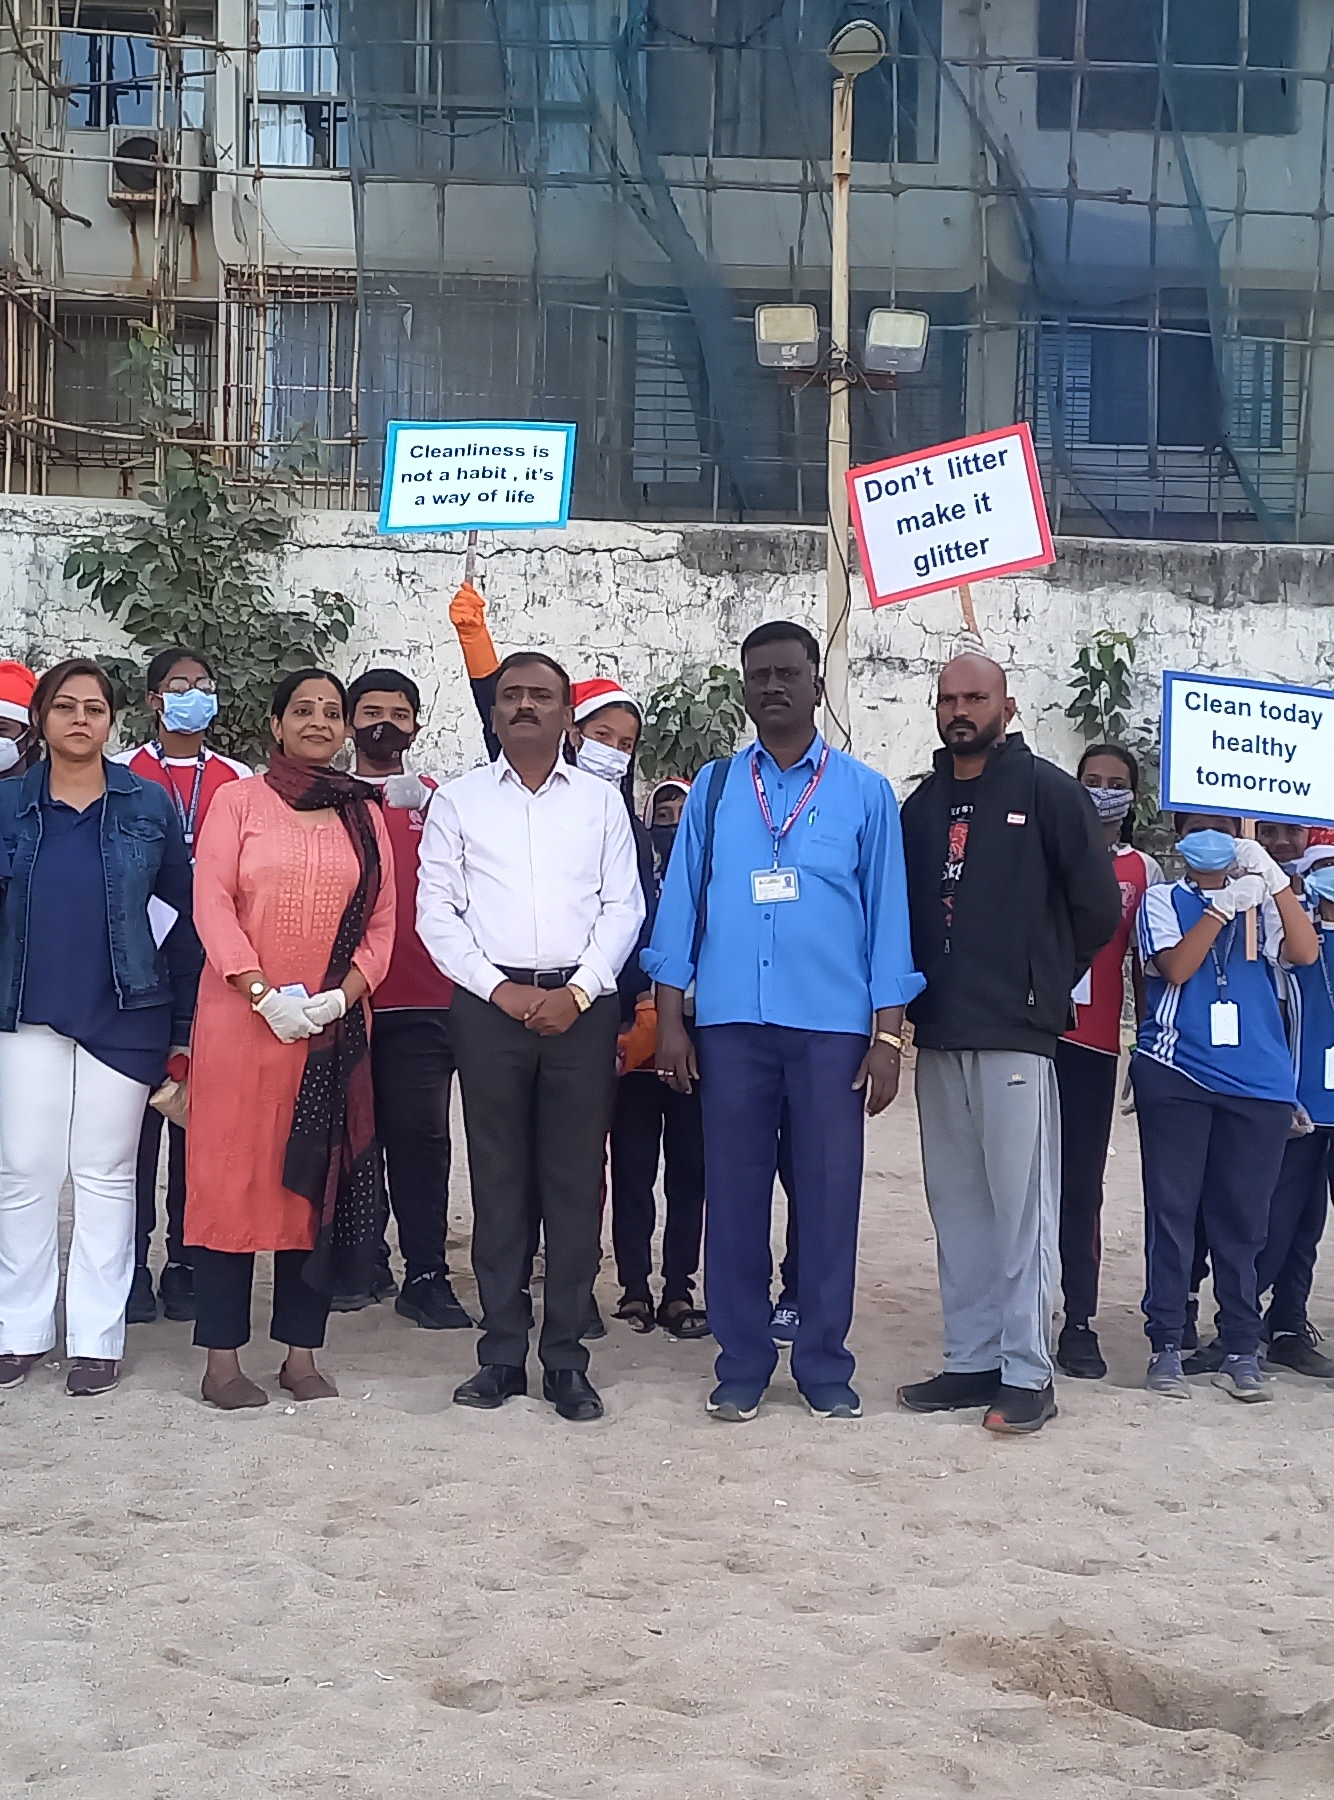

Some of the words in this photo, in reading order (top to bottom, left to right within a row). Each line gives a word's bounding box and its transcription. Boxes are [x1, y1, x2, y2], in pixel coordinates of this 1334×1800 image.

[410, 444, 526, 458] Cleanliness
[533, 446, 550, 457] is
[401, 469, 433, 483] not
[439, 471, 450, 481] a
[456, 466, 507, 480] habit
[526, 468, 554, 481] it's
[865, 466, 934, 502] Don't
[948, 450, 1008, 479] litter
[415, 495, 425, 505] a
[433, 493, 471, 506] way
[478, 490, 498, 502] of
[506, 490, 535, 503] life
[897, 504, 966, 535] make
[974, 492, 992, 515] it
[914, 538, 990, 577] glitter
[1184, 692, 1251, 717] Clean
[1260, 701, 1323, 731] today
[1213, 730, 1297, 764] healthy
[1197, 767, 1311, 797] tomorrow
